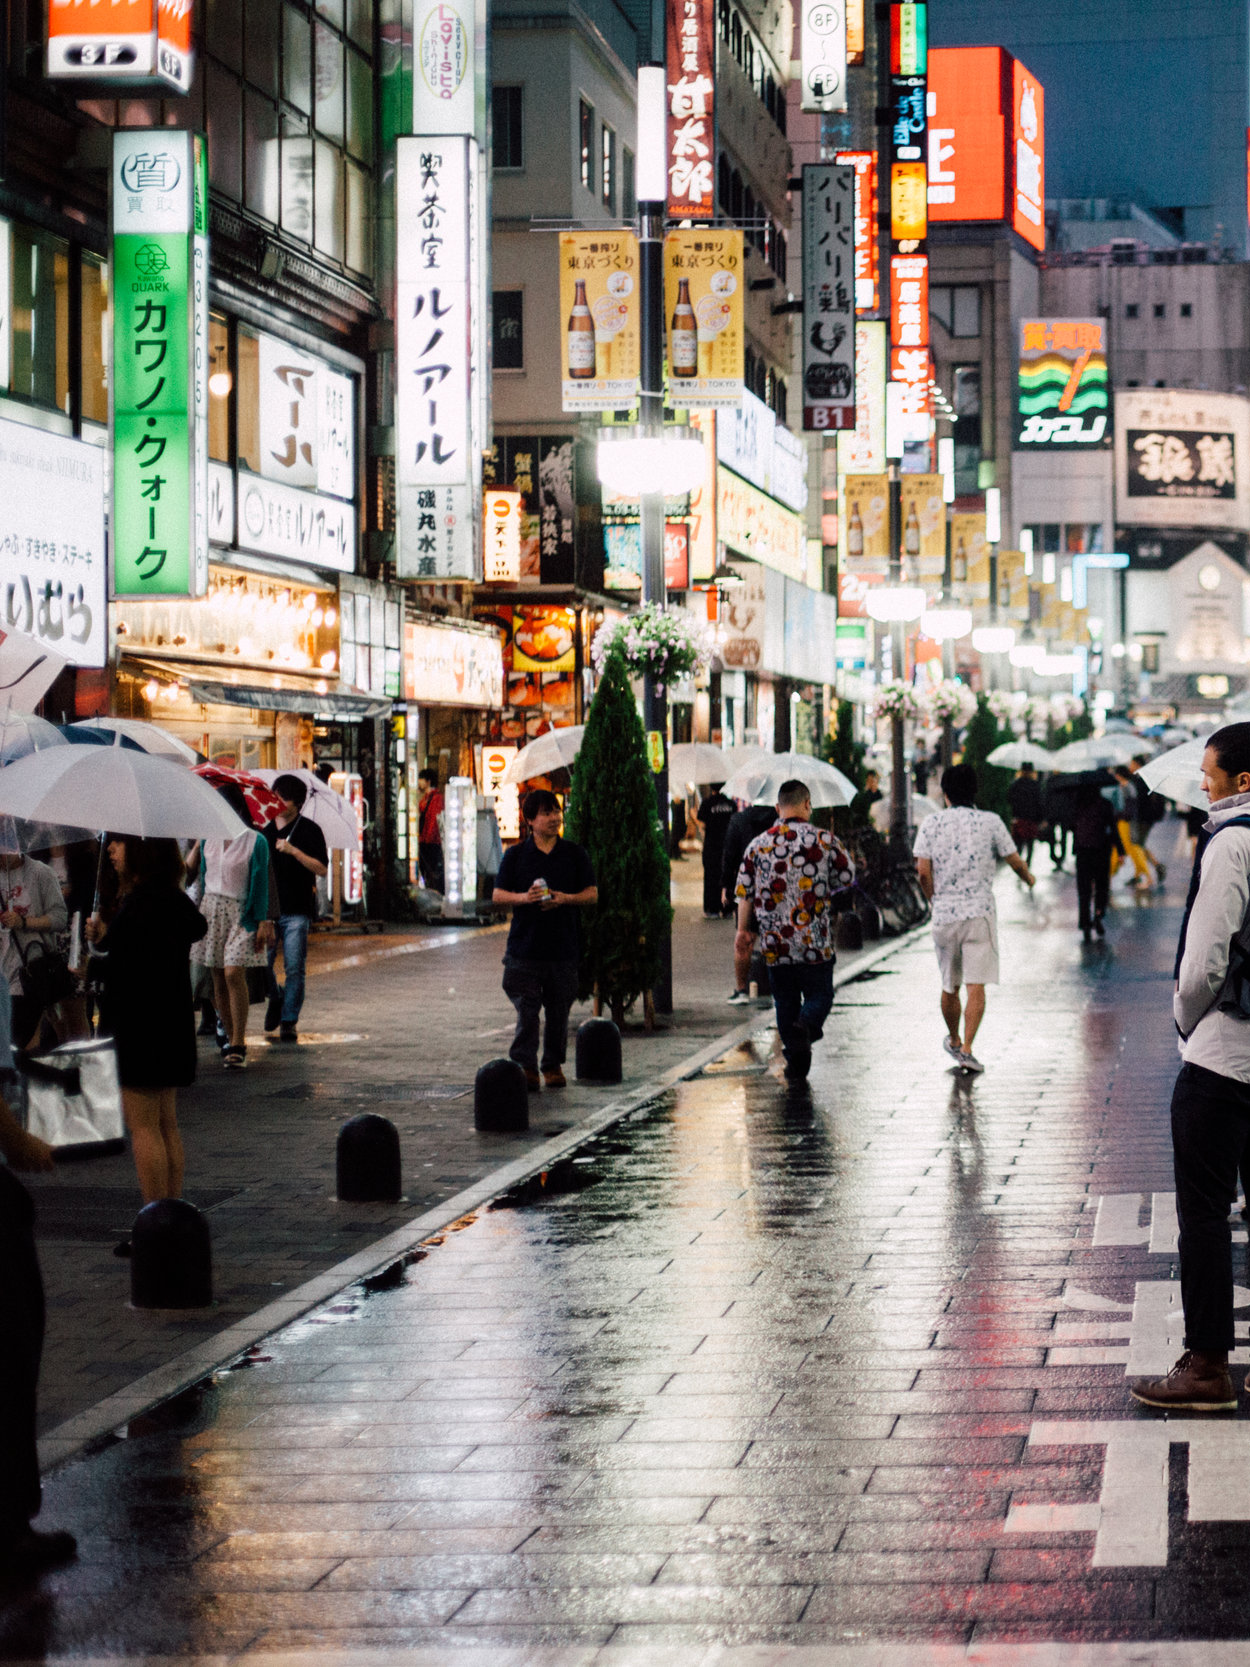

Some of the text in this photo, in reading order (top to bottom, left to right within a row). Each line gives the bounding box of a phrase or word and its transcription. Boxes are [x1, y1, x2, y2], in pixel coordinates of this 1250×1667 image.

[815, 13, 833, 27] 8F
[81, 44, 121, 64] 3F
[164, 51, 178, 76] 3F
[667, 74, 713, 203] 甘太郎
[127, 197, 177, 214] 買取
[580, 243, 619, 253] 一番搾り
[684, 242, 723, 252] 一番搾り
[568, 255, 634, 269] 東京づくり
[672, 254, 738, 269] 東京づくり
[132, 283, 170, 293] QUARK
[413, 287, 457, 467] ルノアール
[812, 408, 844, 428] B1
[134, 300, 167, 581] カワノ・クォーク
[417, 489, 437, 576] 磯丸水産
